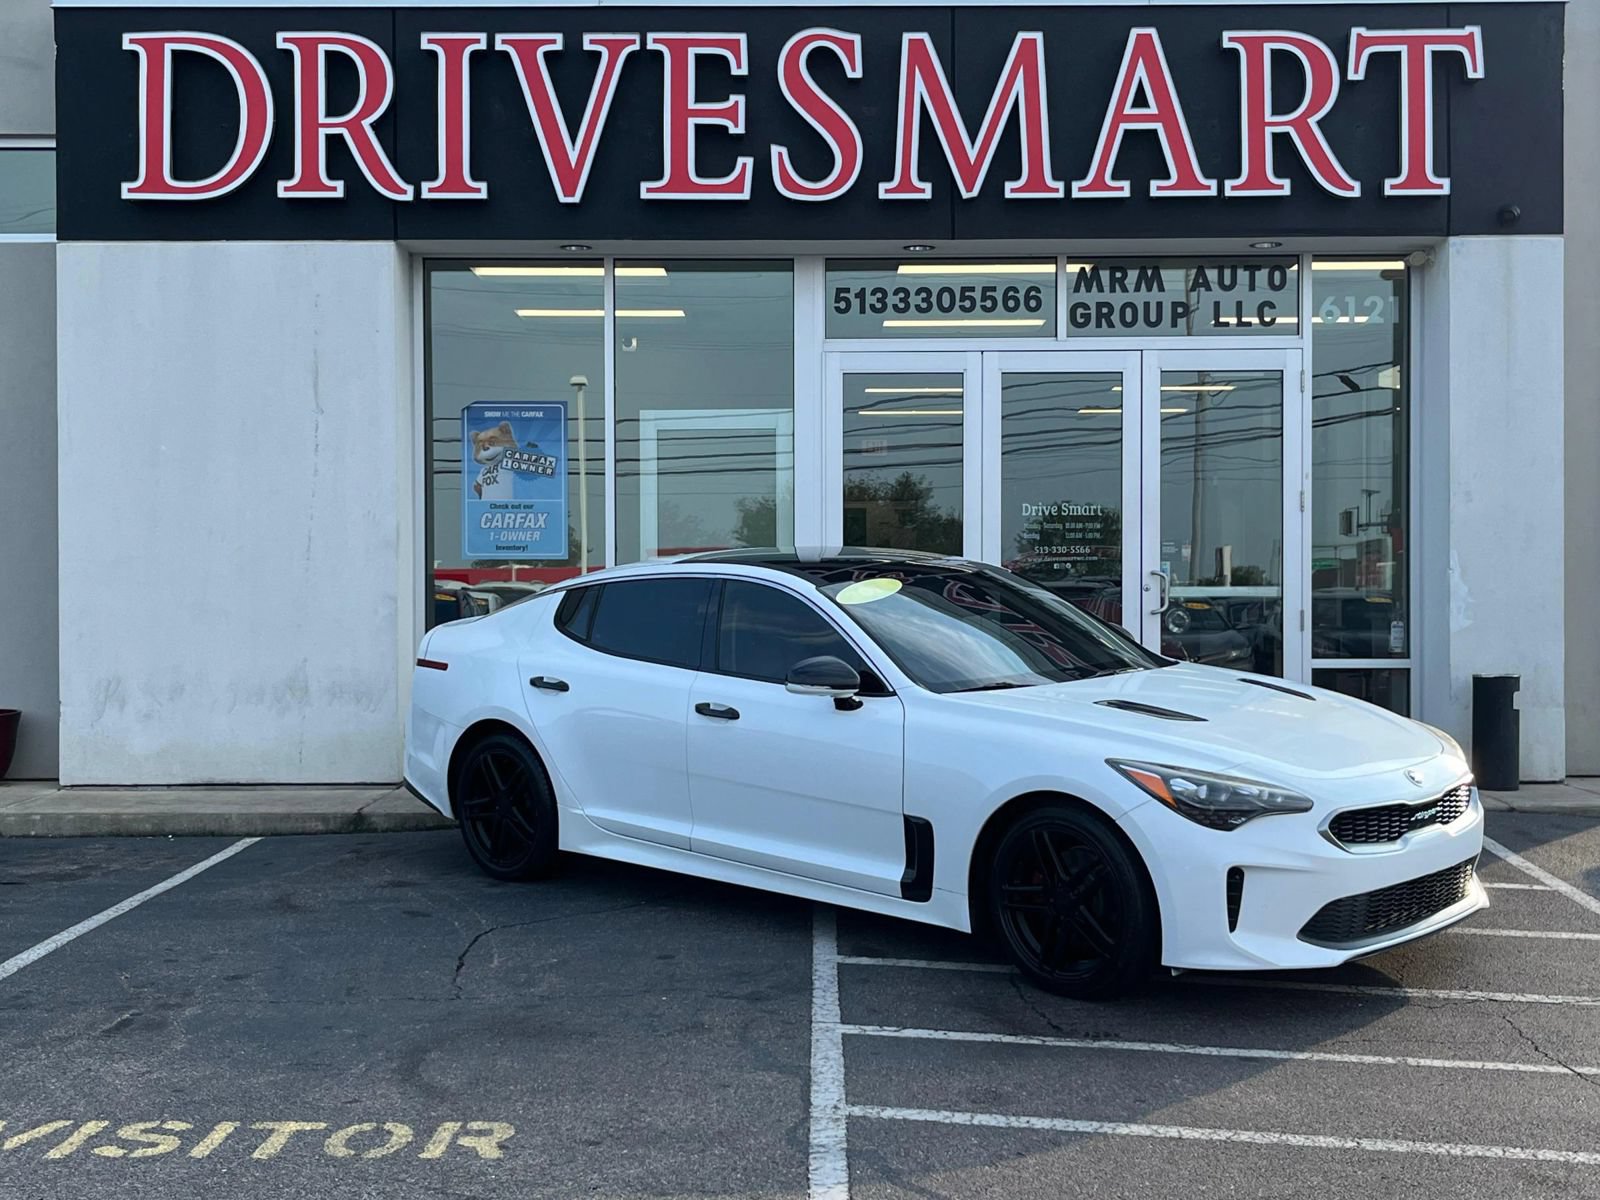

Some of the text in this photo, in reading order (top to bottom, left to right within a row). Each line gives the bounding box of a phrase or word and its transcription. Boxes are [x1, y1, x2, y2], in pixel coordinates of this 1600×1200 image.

[120, 25, 1484, 205] DRIVESMART
[1073, 265, 1288, 293] MRM AUTO
[834, 286, 1043, 315] 5133305566
[1069, 300, 1277, 329] GROUP LLC
[1319, 295, 1400, 324] 6121
[506, 450, 556, 467] CARFAX
[482, 465, 499, 477] CAR
[482, 474, 499, 486] FOX
[1022, 502, 1102, 516] Drive Smart
[480, 512, 548, 529] CARFAX
[1034, 545, 1091, 554] 513-330-5566
